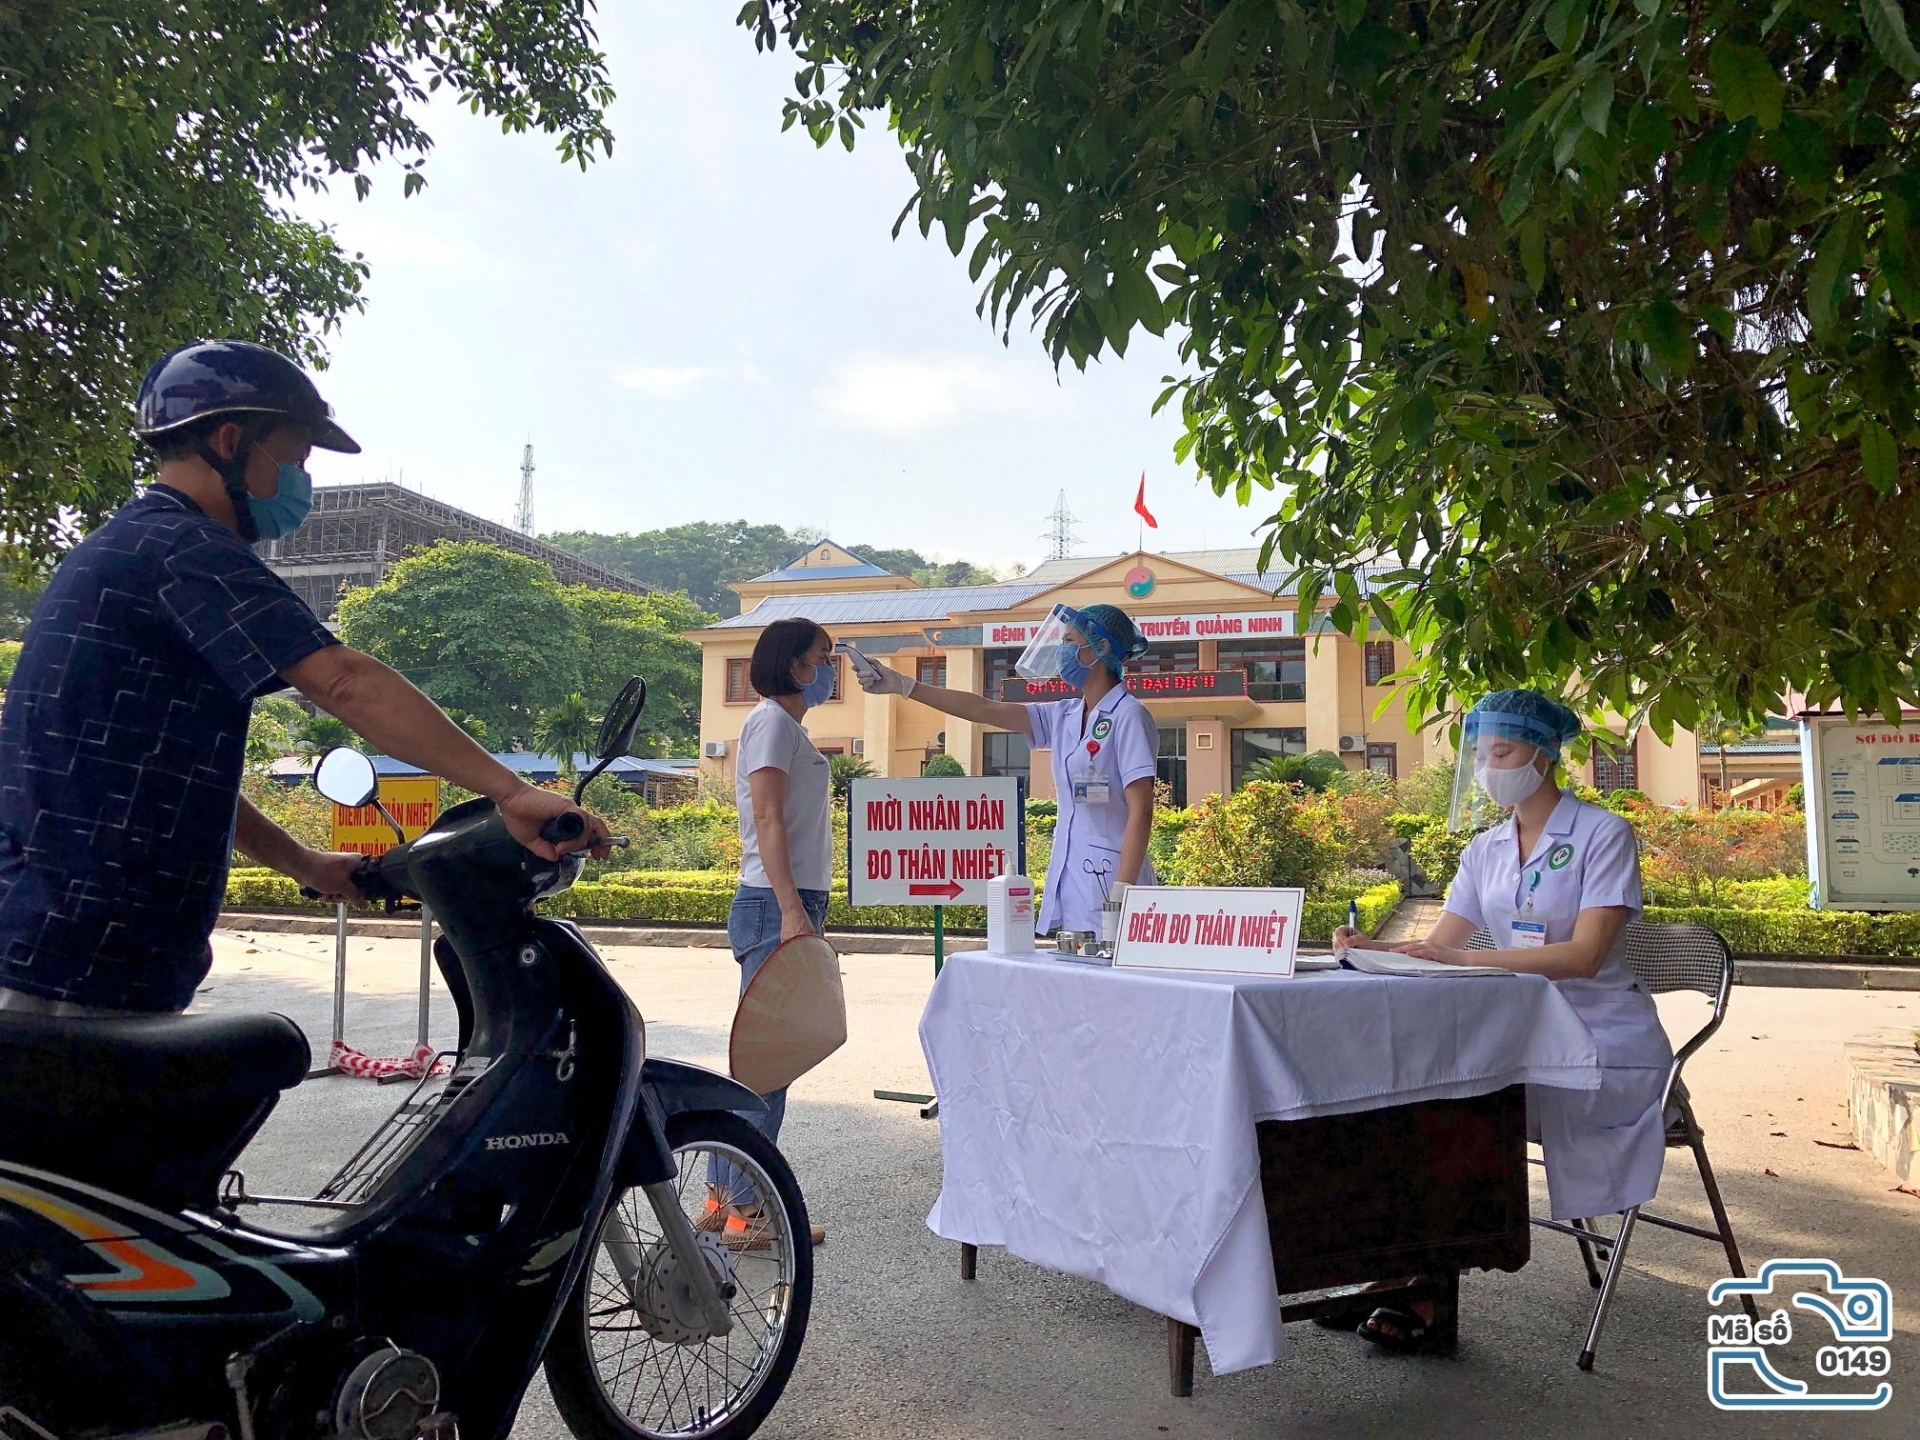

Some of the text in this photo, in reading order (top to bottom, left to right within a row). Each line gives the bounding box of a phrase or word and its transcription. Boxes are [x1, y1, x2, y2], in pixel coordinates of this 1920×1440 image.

[992, 625, 1025, 644] BỆNH
[1139, 616, 1190, 636] TRUYỀN
[1196, 614, 1242, 635] QUẢNG
[1248, 617, 1282, 632] NINH
[406, 798, 433, 831] NHIỆT
[867, 793, 1004, 831] MỜI NHÂN DÂN
[867, 849, 892, 880] ĐO
[898, 842, 945, 880] THÂN
[1128, 902, 1287, 954] ĐIỂM ĐO THÂN NHIỆT
[485, 1132, 570, 1150] HONDA
